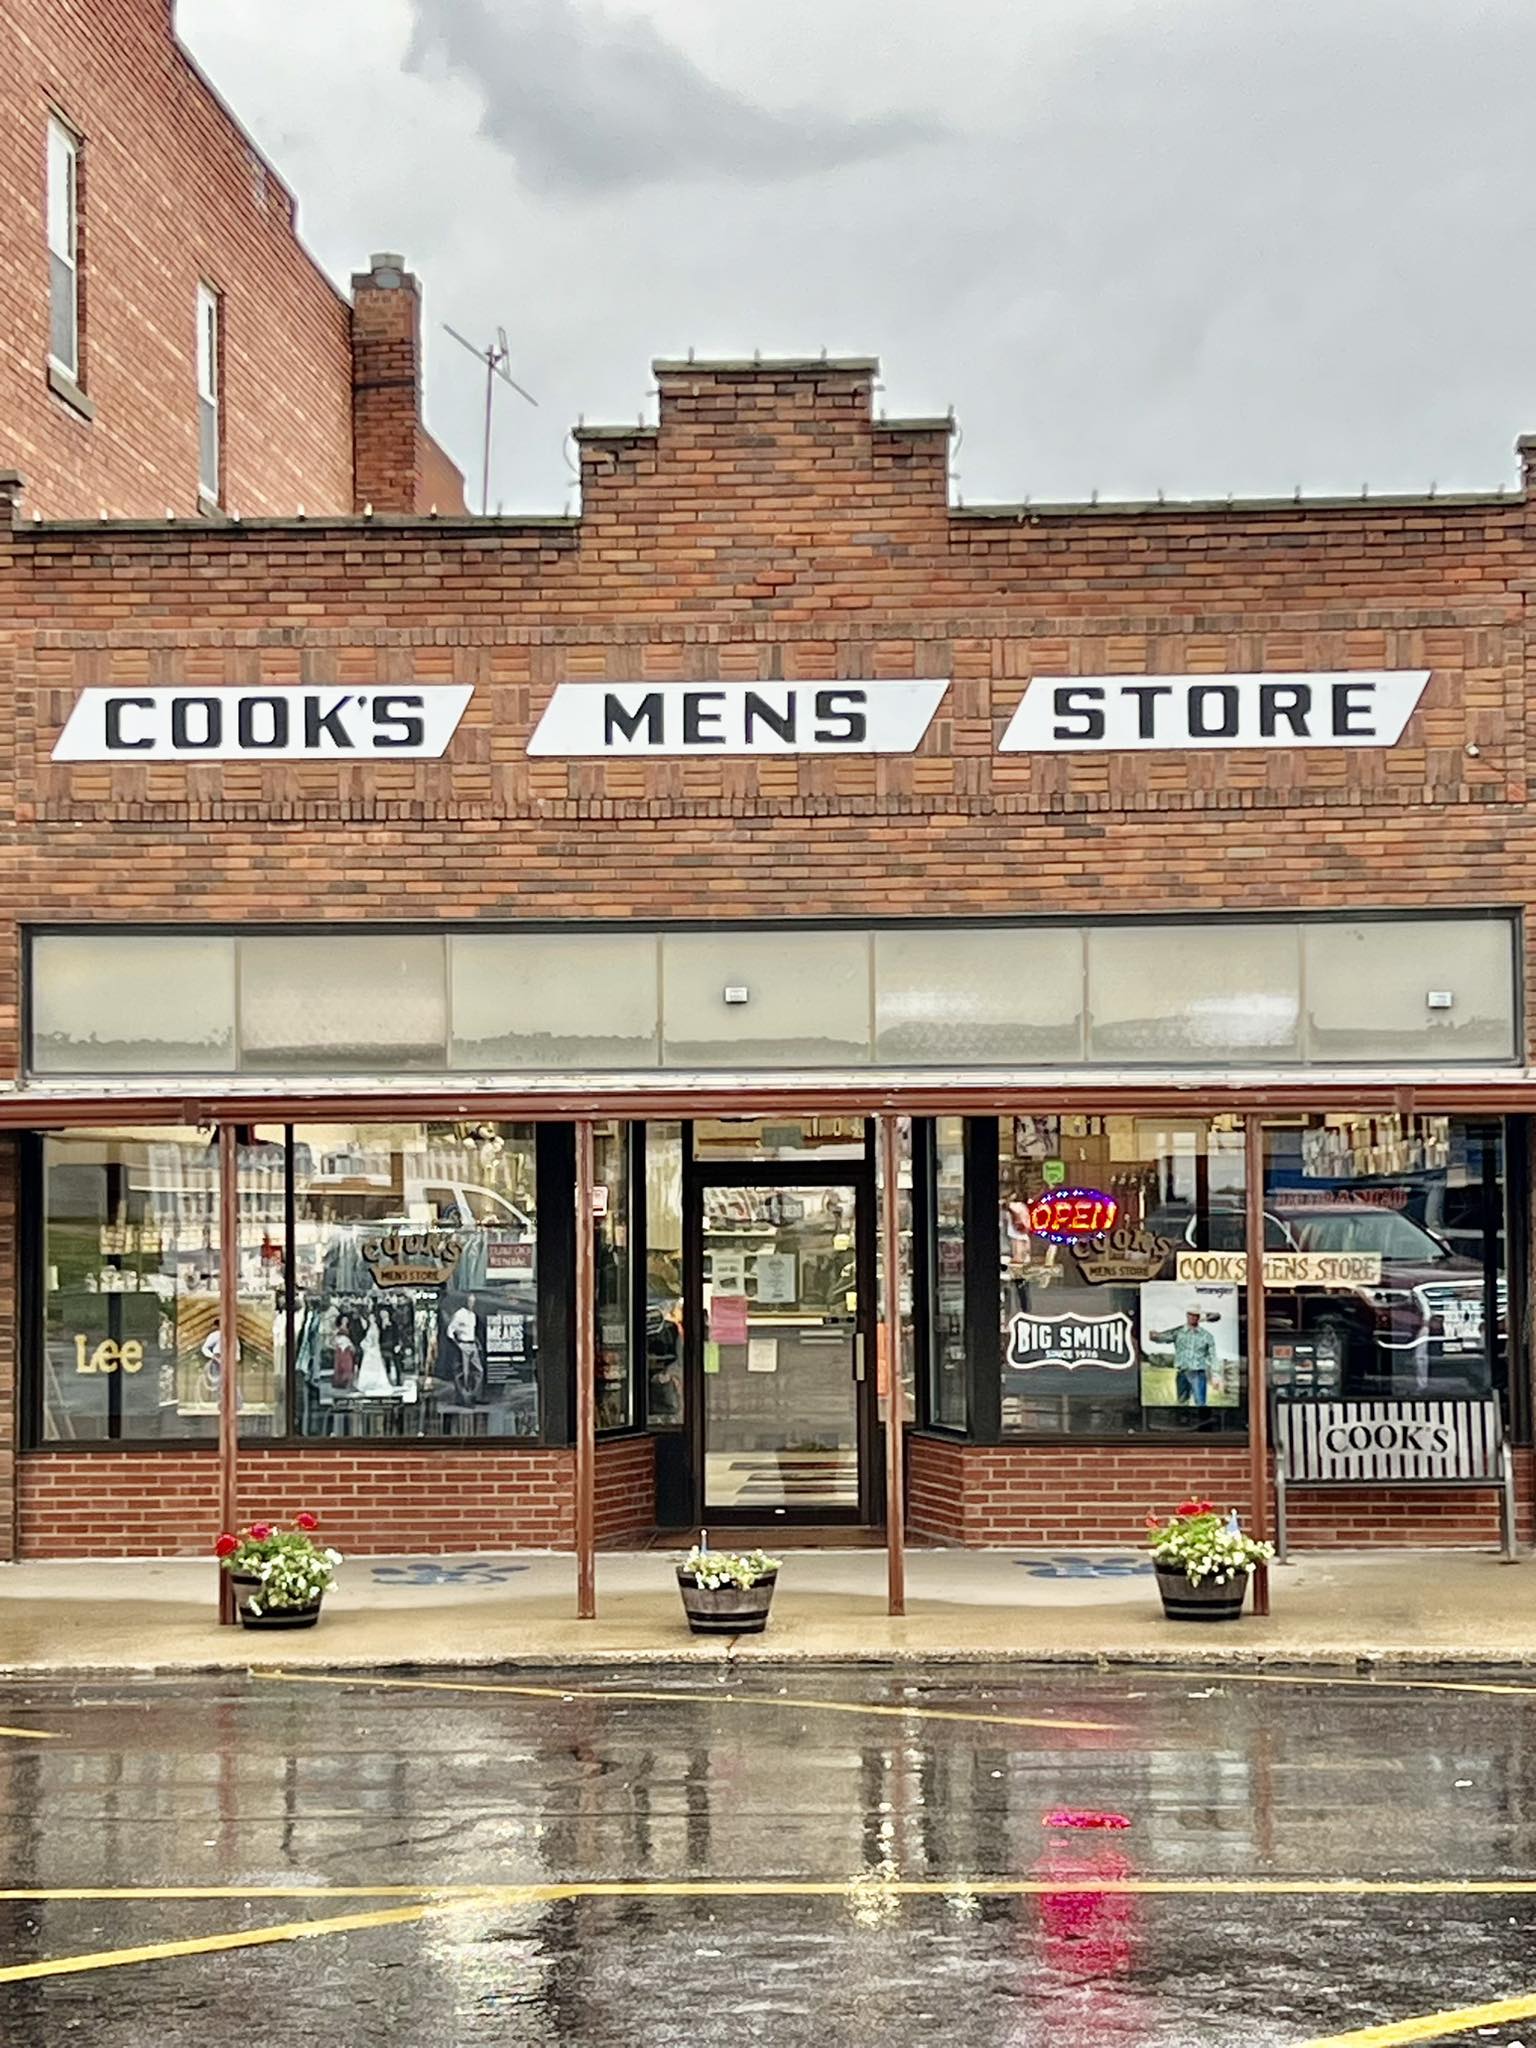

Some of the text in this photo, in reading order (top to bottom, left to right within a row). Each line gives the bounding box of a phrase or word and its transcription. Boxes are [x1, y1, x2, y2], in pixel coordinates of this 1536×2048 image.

[105, 683, 1376, 749] COOK'S MENS STORE
[1031, 1201, 1117, 1230] OPEN
[1314, 1256, 1377, 1282] STORE
[1018, 1320, 1123, 1354] BIG SMITH
[74, 1333, 144, 1374] Lee
[1326, 1424, 1449, 1454] COOK'S
